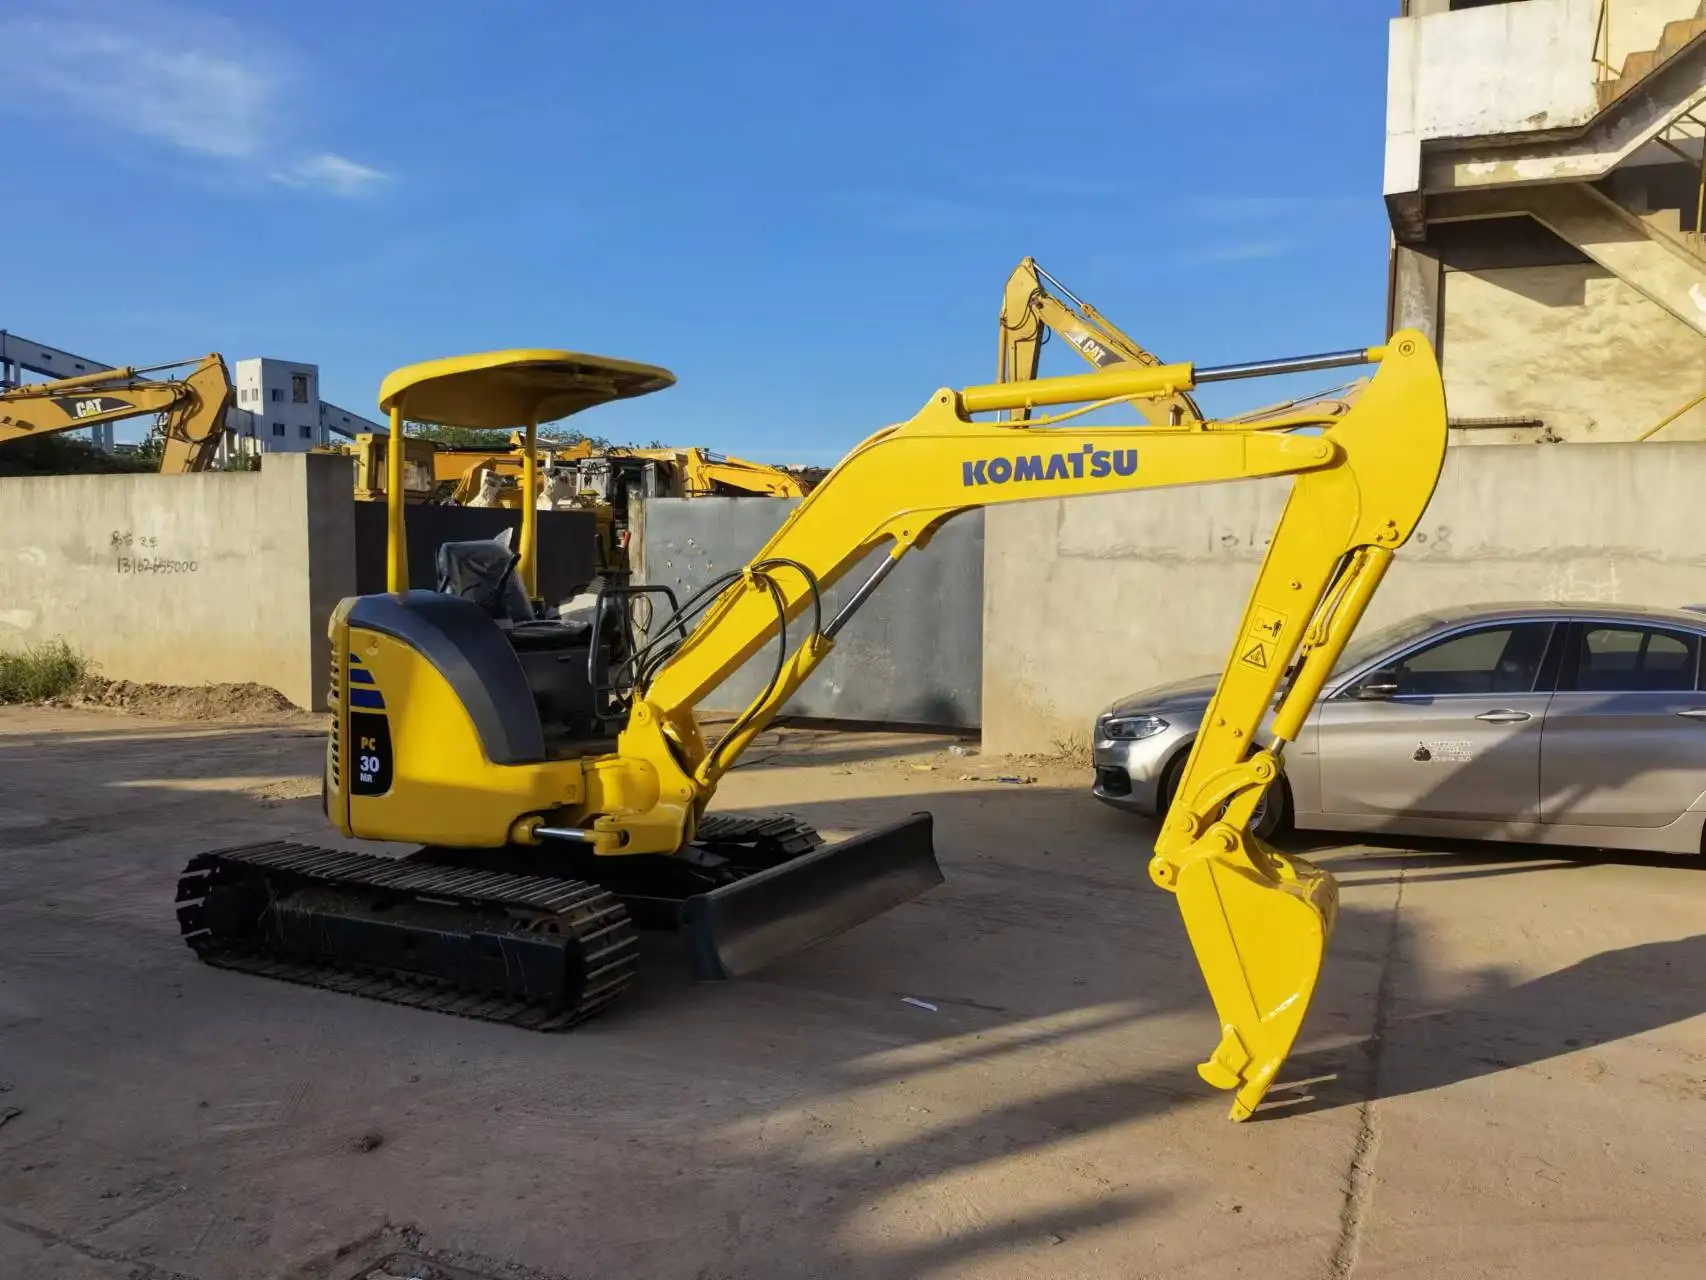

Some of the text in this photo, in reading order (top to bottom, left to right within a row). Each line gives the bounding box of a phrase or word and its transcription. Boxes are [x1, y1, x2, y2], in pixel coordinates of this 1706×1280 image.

[1083, 340, 1106, 364] CAT
[75, 398, 102, 418] CAT
[962, 443, 1138, 487] KOMATSU
[360, 736, 376, 751] PC
[359, 755, 380, 773] 30
[360, 773, 373, 783] MR
